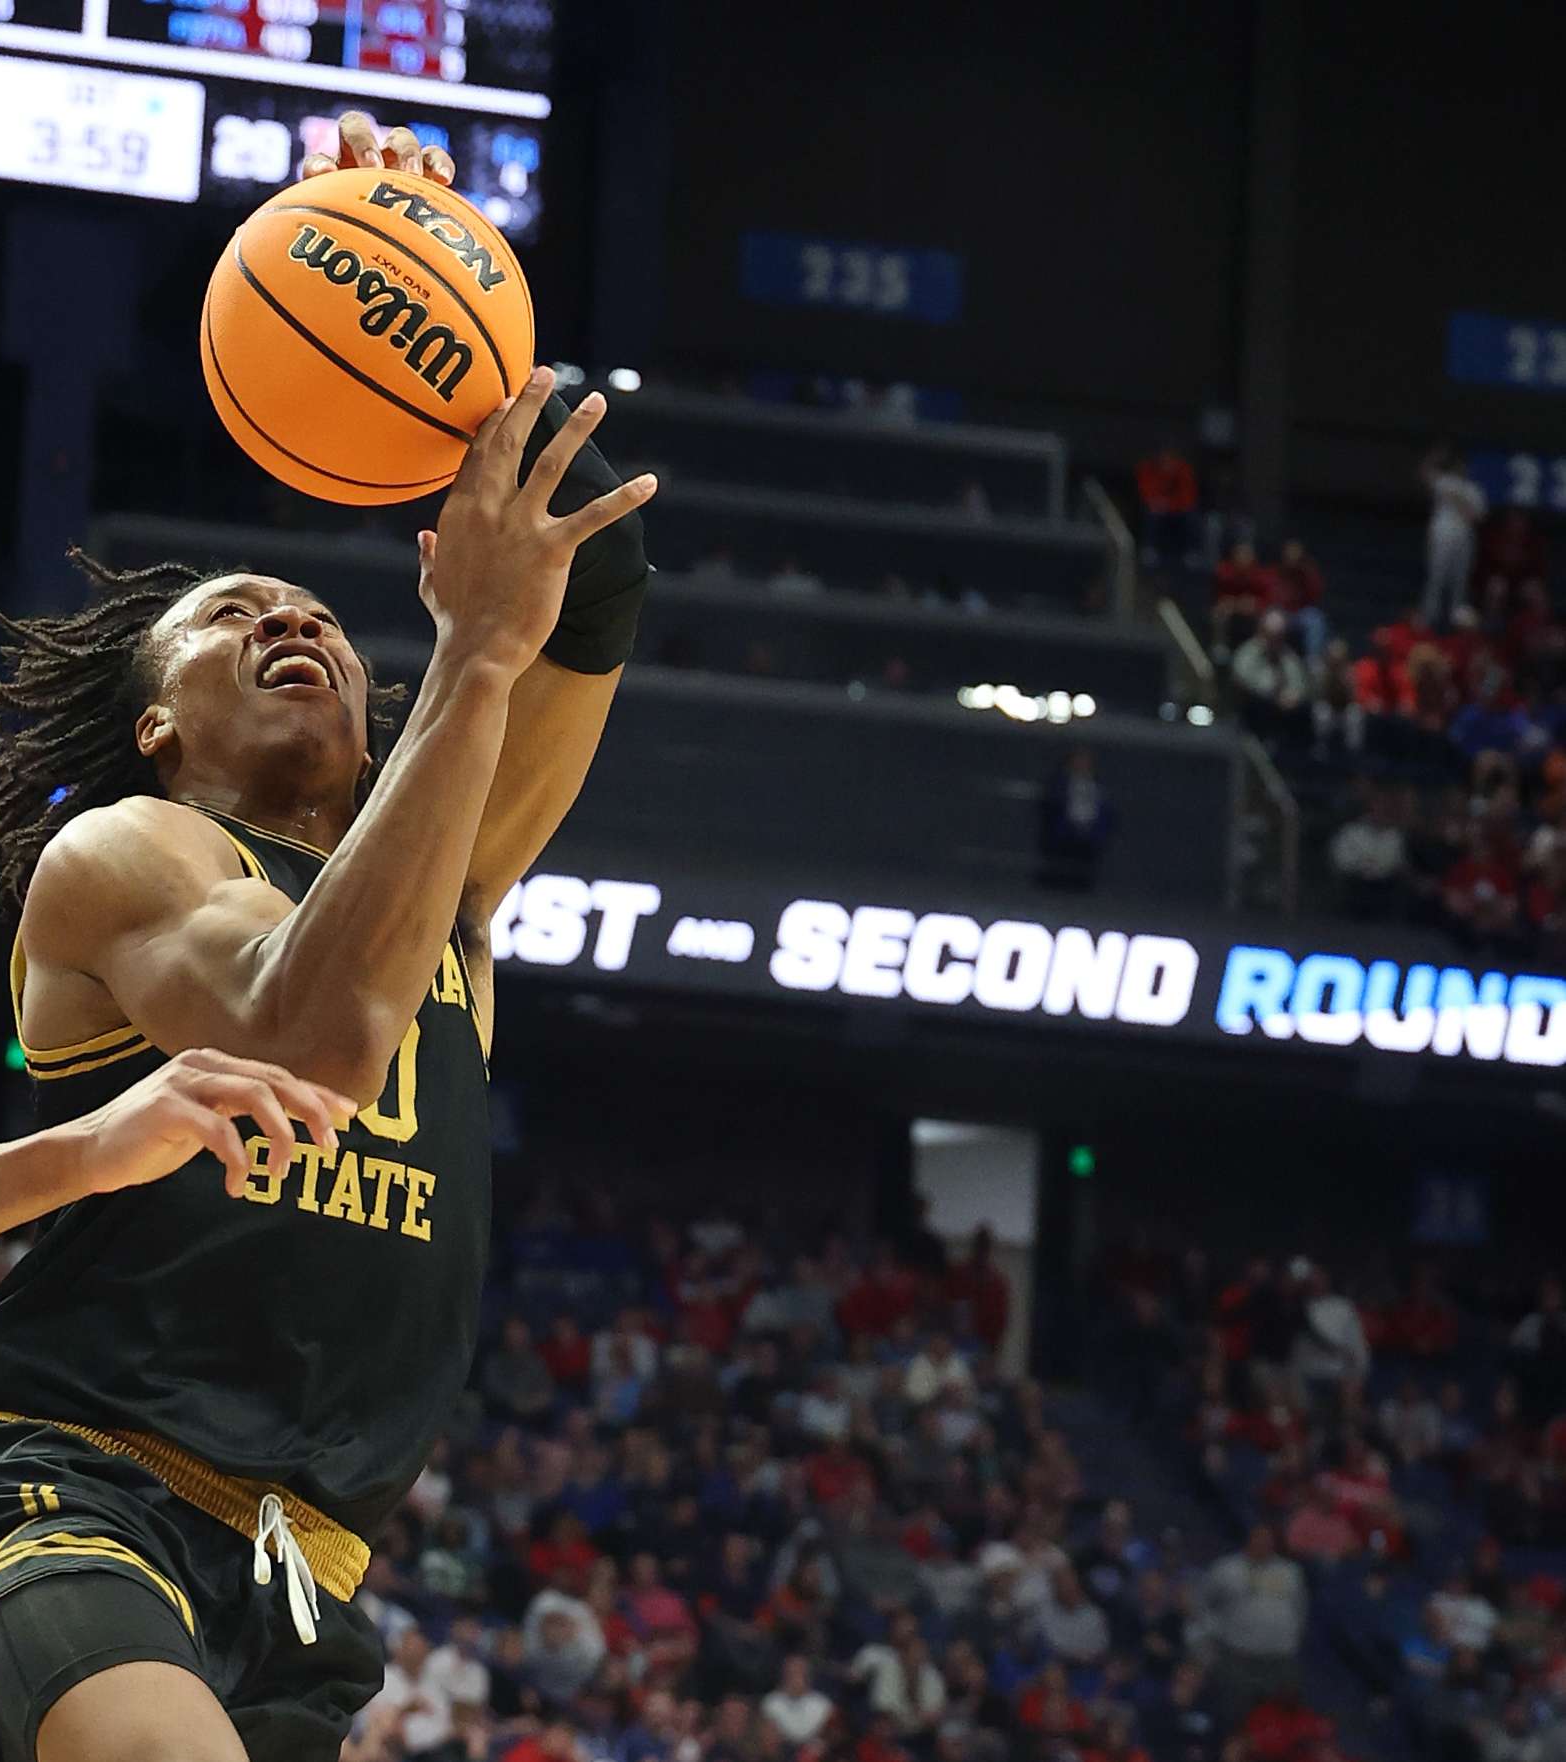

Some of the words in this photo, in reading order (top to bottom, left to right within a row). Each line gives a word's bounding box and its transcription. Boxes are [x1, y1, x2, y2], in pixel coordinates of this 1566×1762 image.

[368, 181, 507, 292] NCAA
[370, 253, 403, 278] NXT
[402, 275, 432, 301] EVO
[290, 225, 474, 404] Wilson
[666, 916, 755, 963] AND
[769, 899, 1200, 1026] SECOND
[1215, 944, 1566, 1067] ROUND
[244, 1135, 436, 1242] STATE
